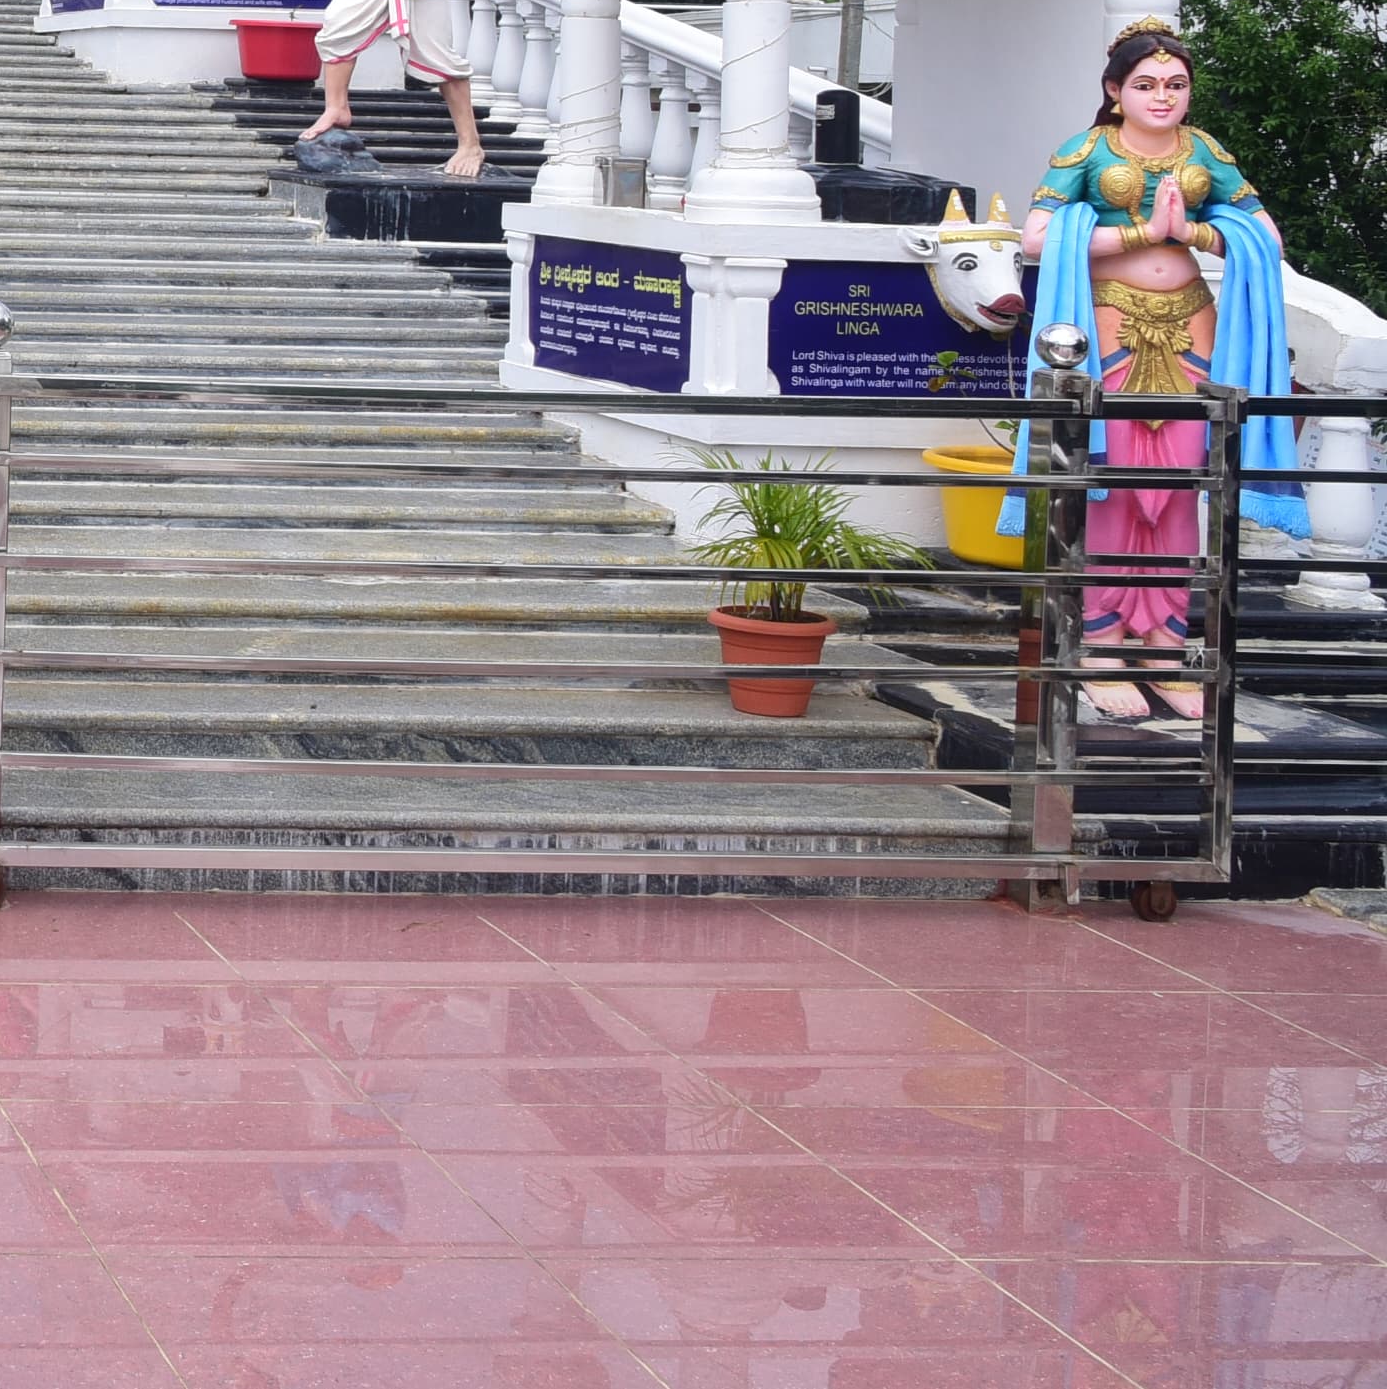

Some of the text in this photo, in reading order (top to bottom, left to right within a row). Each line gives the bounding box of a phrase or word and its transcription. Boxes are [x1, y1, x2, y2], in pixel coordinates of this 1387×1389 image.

[848, 284, 870, 297] SRI
[794, 301, 924, 317] GRISHNESHWARA
[836, 322, 880, 335] LINGA
[792, 351, 815, 360] Lord
[816, 351, 845, 361] Shiva
[847, 352, 855, 361] is
[856, 352, 896, 363] pleased
[898, 352, 918, 362] with
[921, 353, 937, 362] the
[791, 365, 804, 373] as
[809, 364, 871, 376] Shivalingam
[876, 365, 888, 377] by
[894, 366, 909, 375] the
[915, 368, 944, 376] name
[791, 376, 844, 389] Shivalinga
[845, 378, 865, 387] with
[867, 380, 895, 388] water
[896, 379, 914, 388] will
[979, 380, 1000, 389] kind
